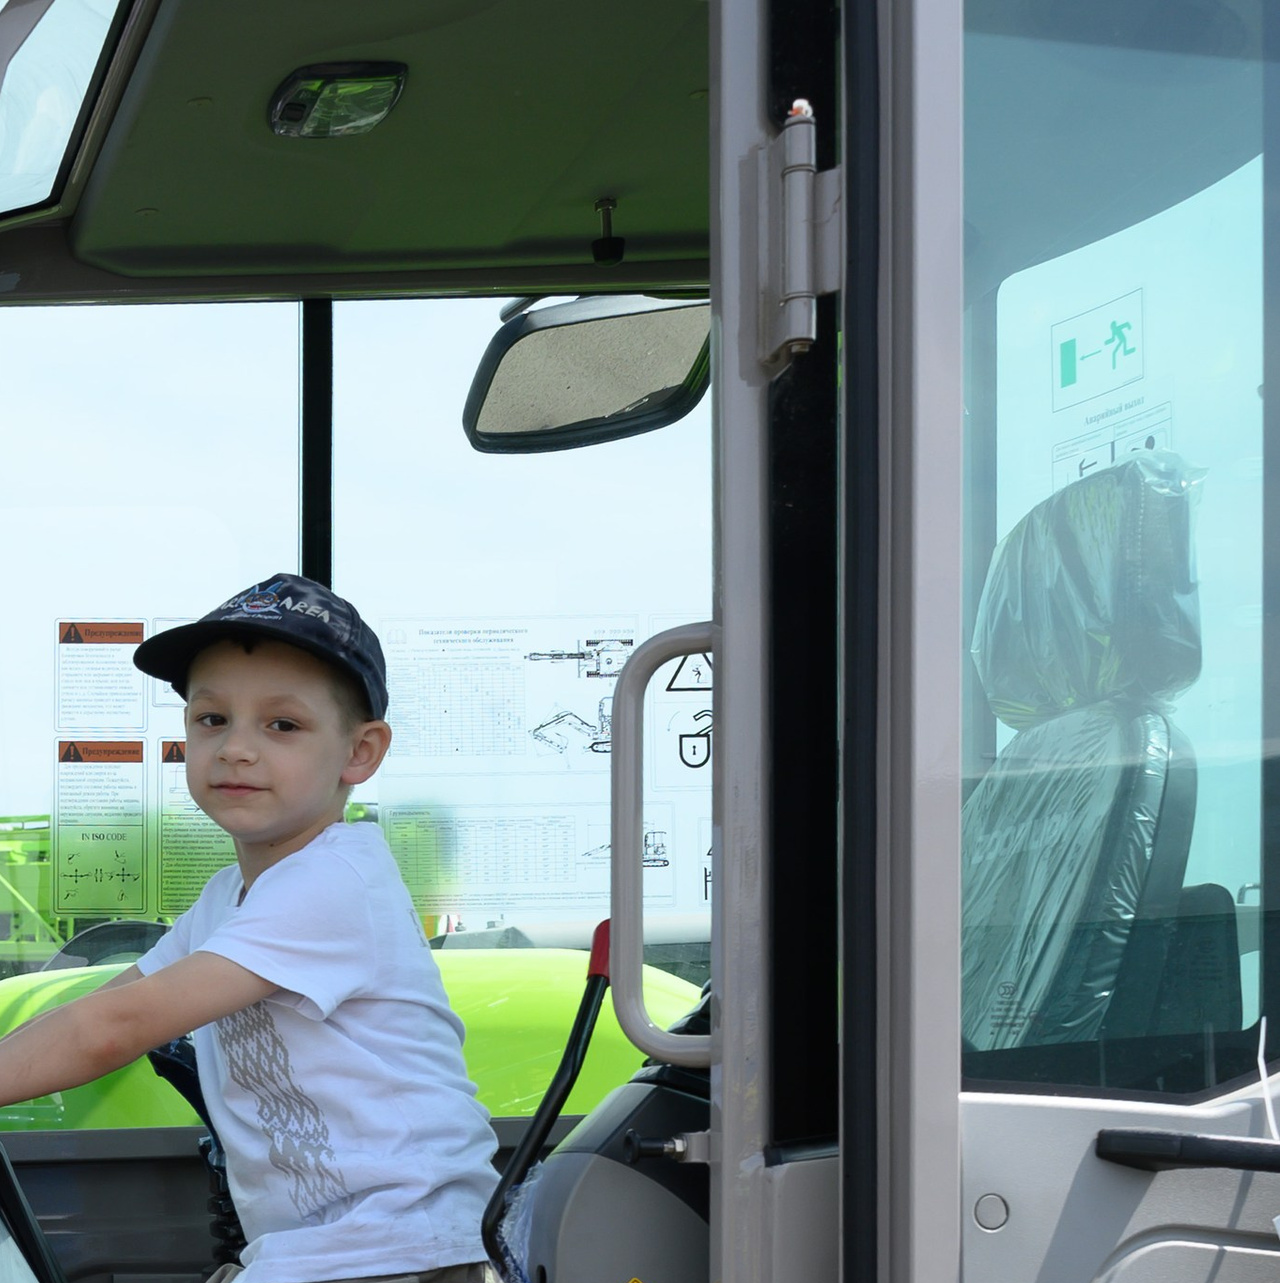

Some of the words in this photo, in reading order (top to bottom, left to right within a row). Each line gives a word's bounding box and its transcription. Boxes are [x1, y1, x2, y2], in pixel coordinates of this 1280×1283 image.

[278, 596, 331, 623] AREA
[81, 833, 91, 841] IN
[92, 833, 105, 841] ISO
[106, 833, 127, 841] CODE
